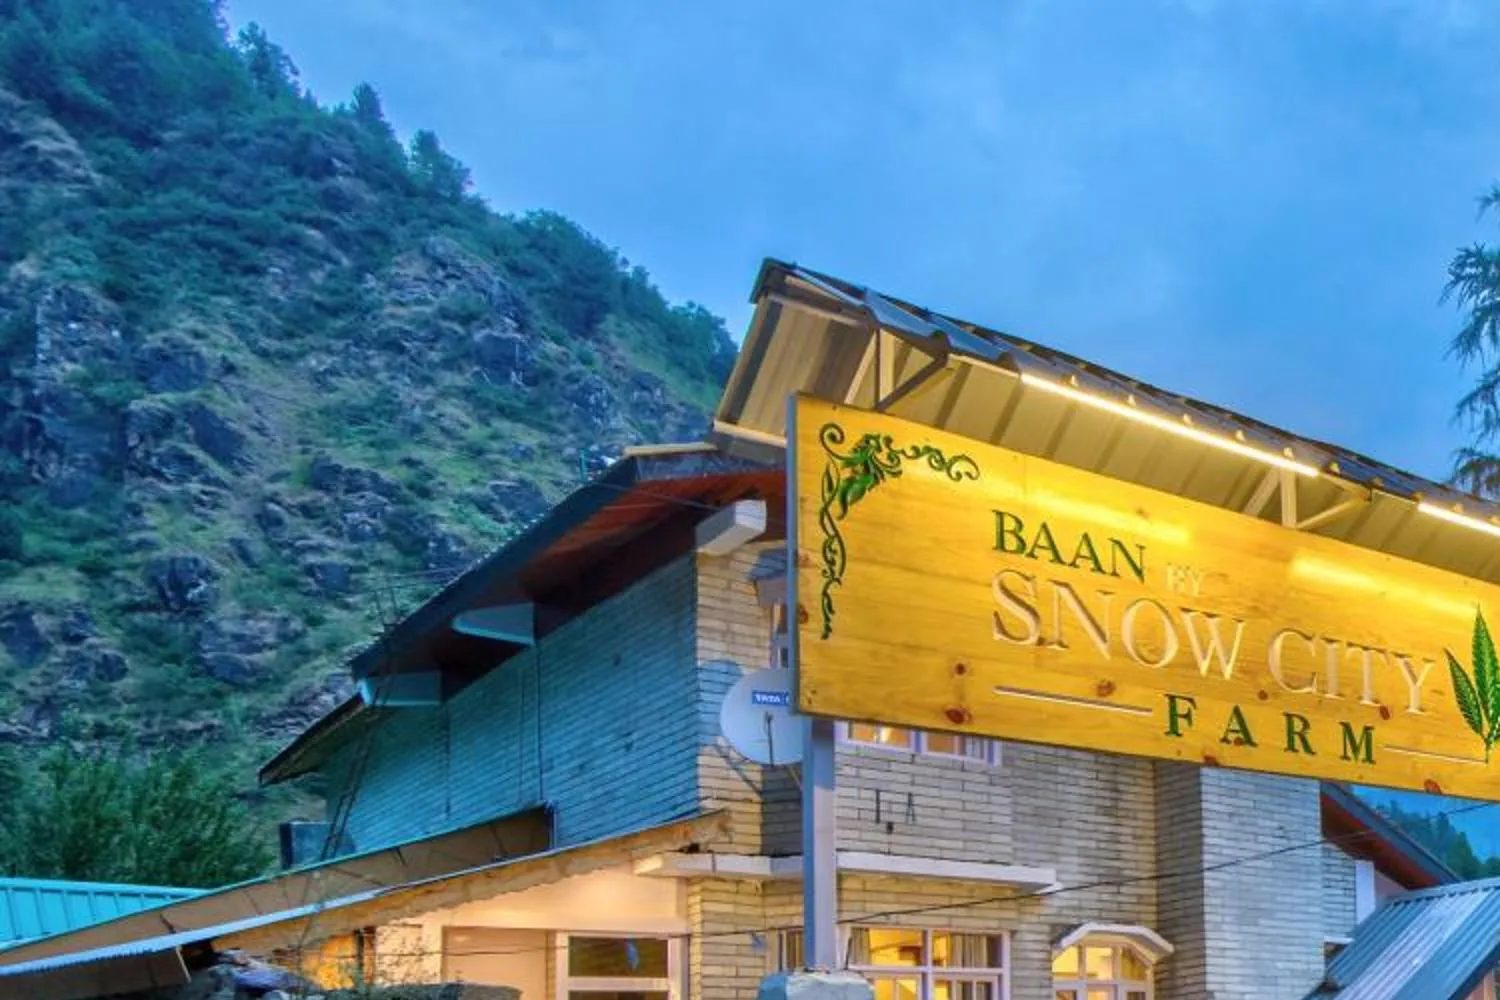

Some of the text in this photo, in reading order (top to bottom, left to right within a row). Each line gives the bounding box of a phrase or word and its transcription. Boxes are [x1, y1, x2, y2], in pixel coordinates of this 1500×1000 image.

[991, 508, 1208, 598] BAAN BY
[991, 568, 1437, 715] SNOW CITY
[754, 693, 781, 704] TATA
[1163, 692, 1377, 765] FARM
